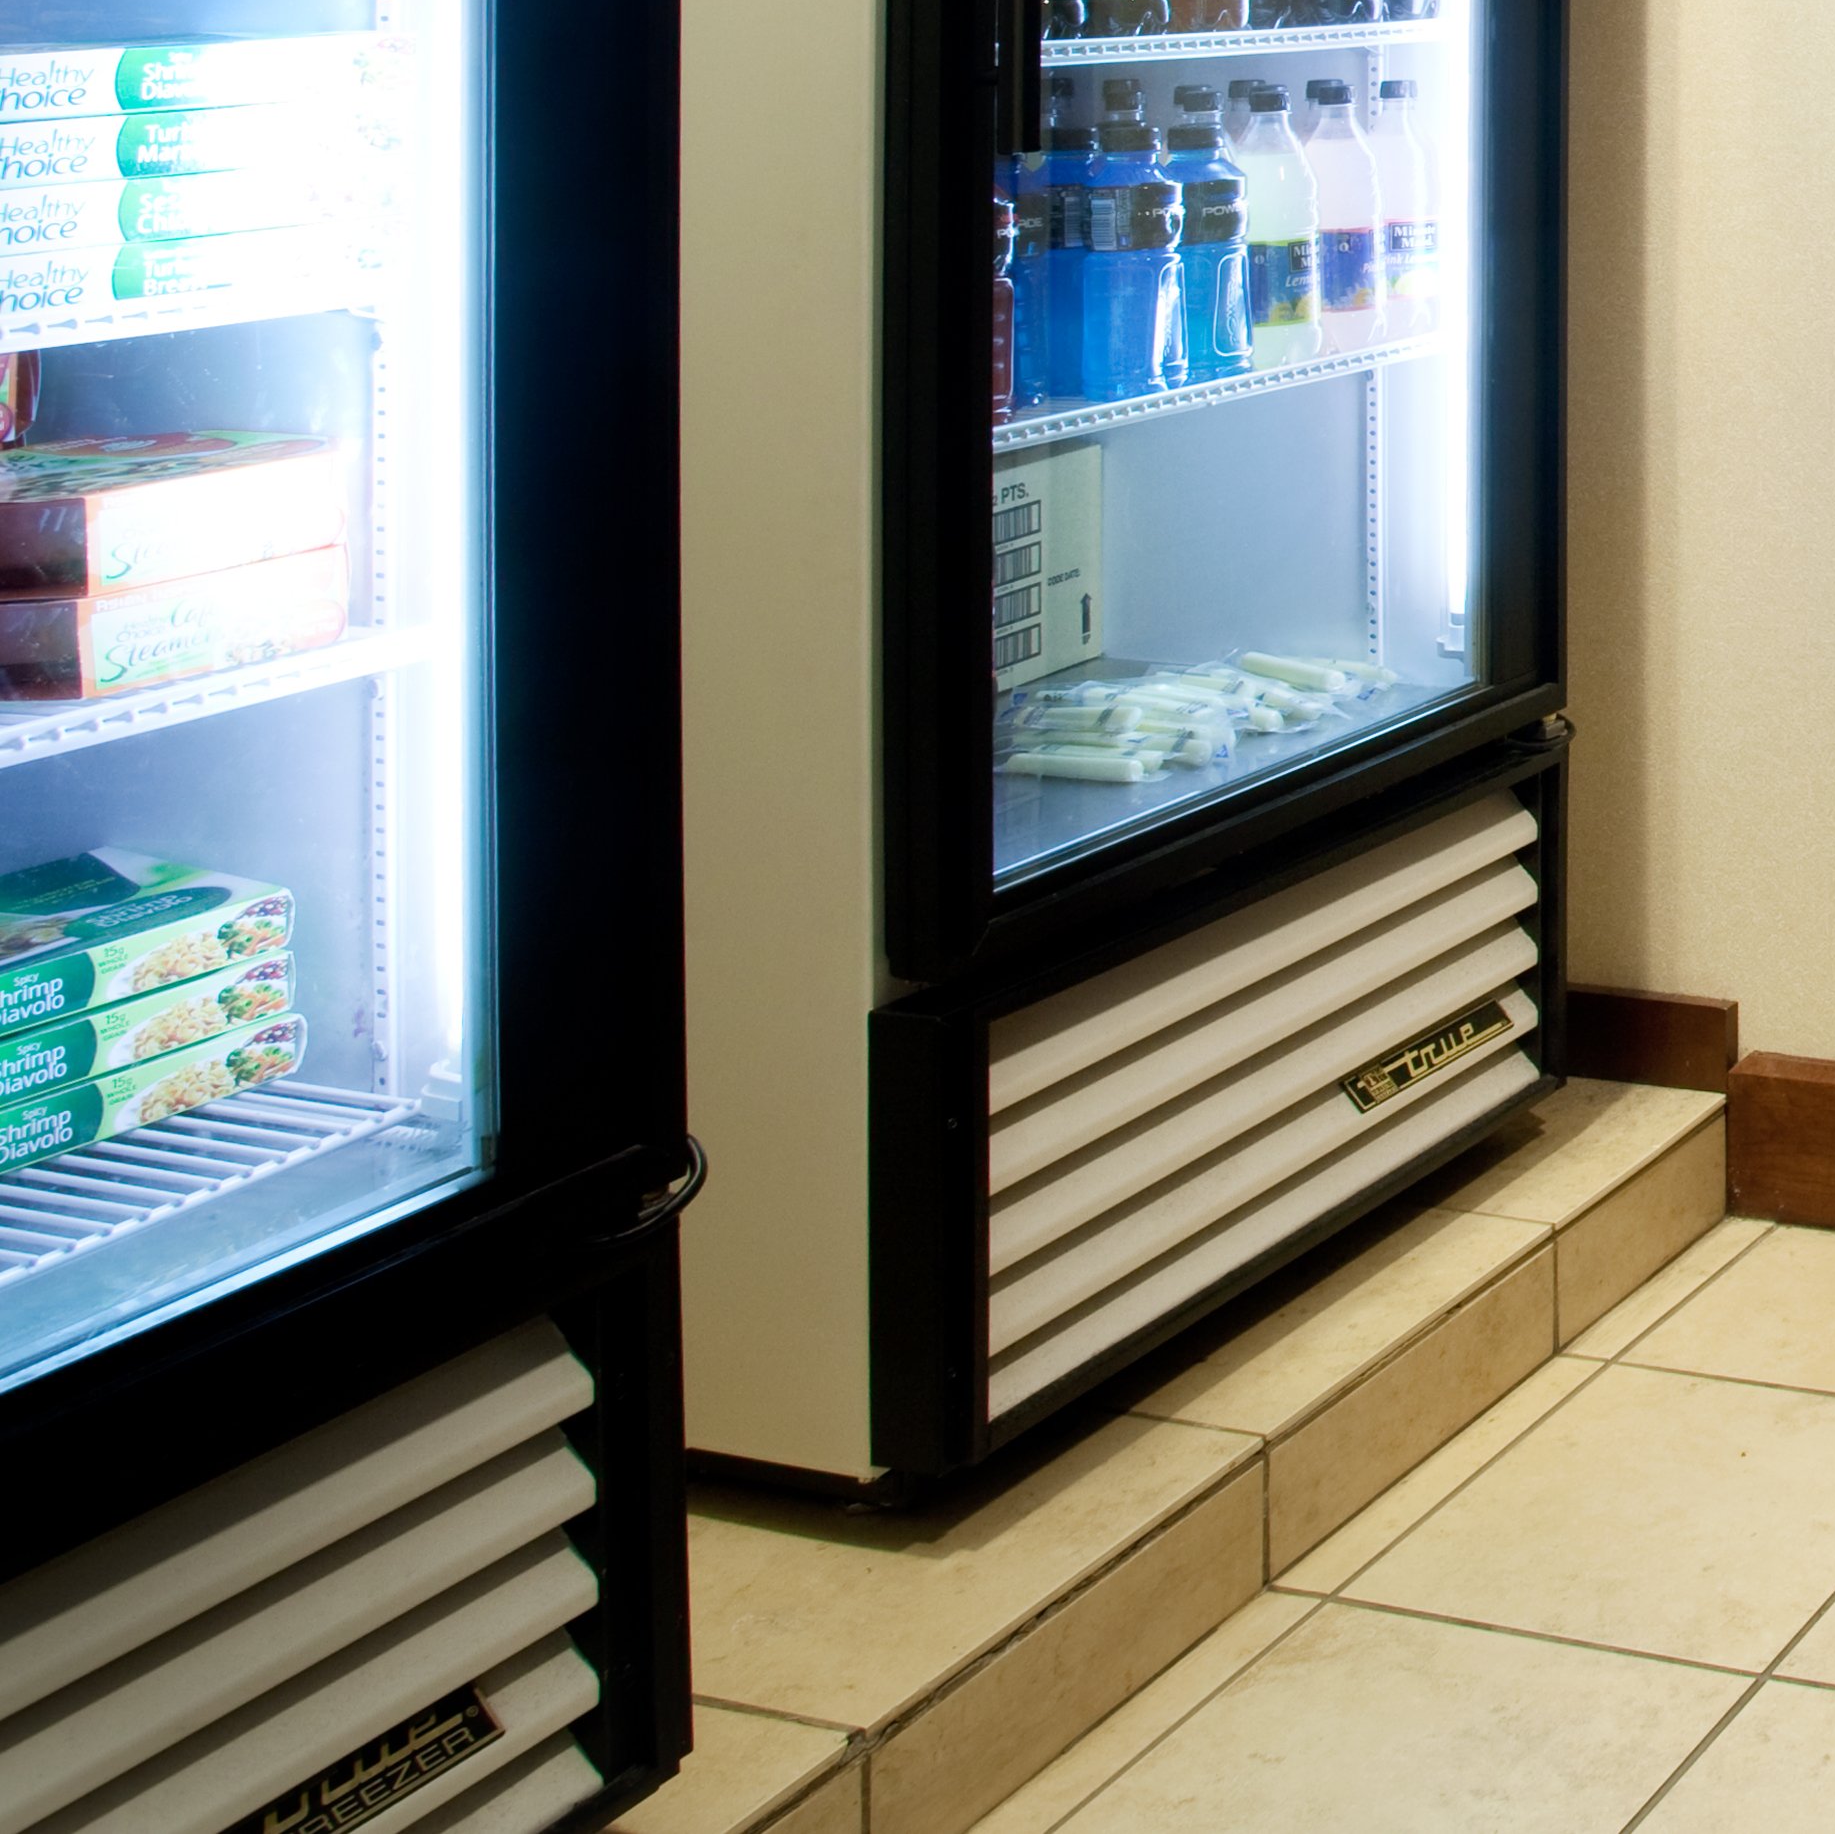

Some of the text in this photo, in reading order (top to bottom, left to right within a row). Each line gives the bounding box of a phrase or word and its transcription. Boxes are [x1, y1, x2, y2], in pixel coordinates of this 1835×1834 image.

[0, 85, 87, 111] hoice
[0, 153, 88, 180] hoice
[0, 285, 84, 312] hoice
[1001, 482, 1030, 504] PTS.
[0, 978, 63, 1006] hrimp
[13, 972, 39, 986] Spicy
[0, 994, 65, 1025] iavolo
[16, 1041, 42, 1055] Spicy
[22, 1106, 48, 1120] Spicy
[290, 1726, 476, 1834] REEZER
